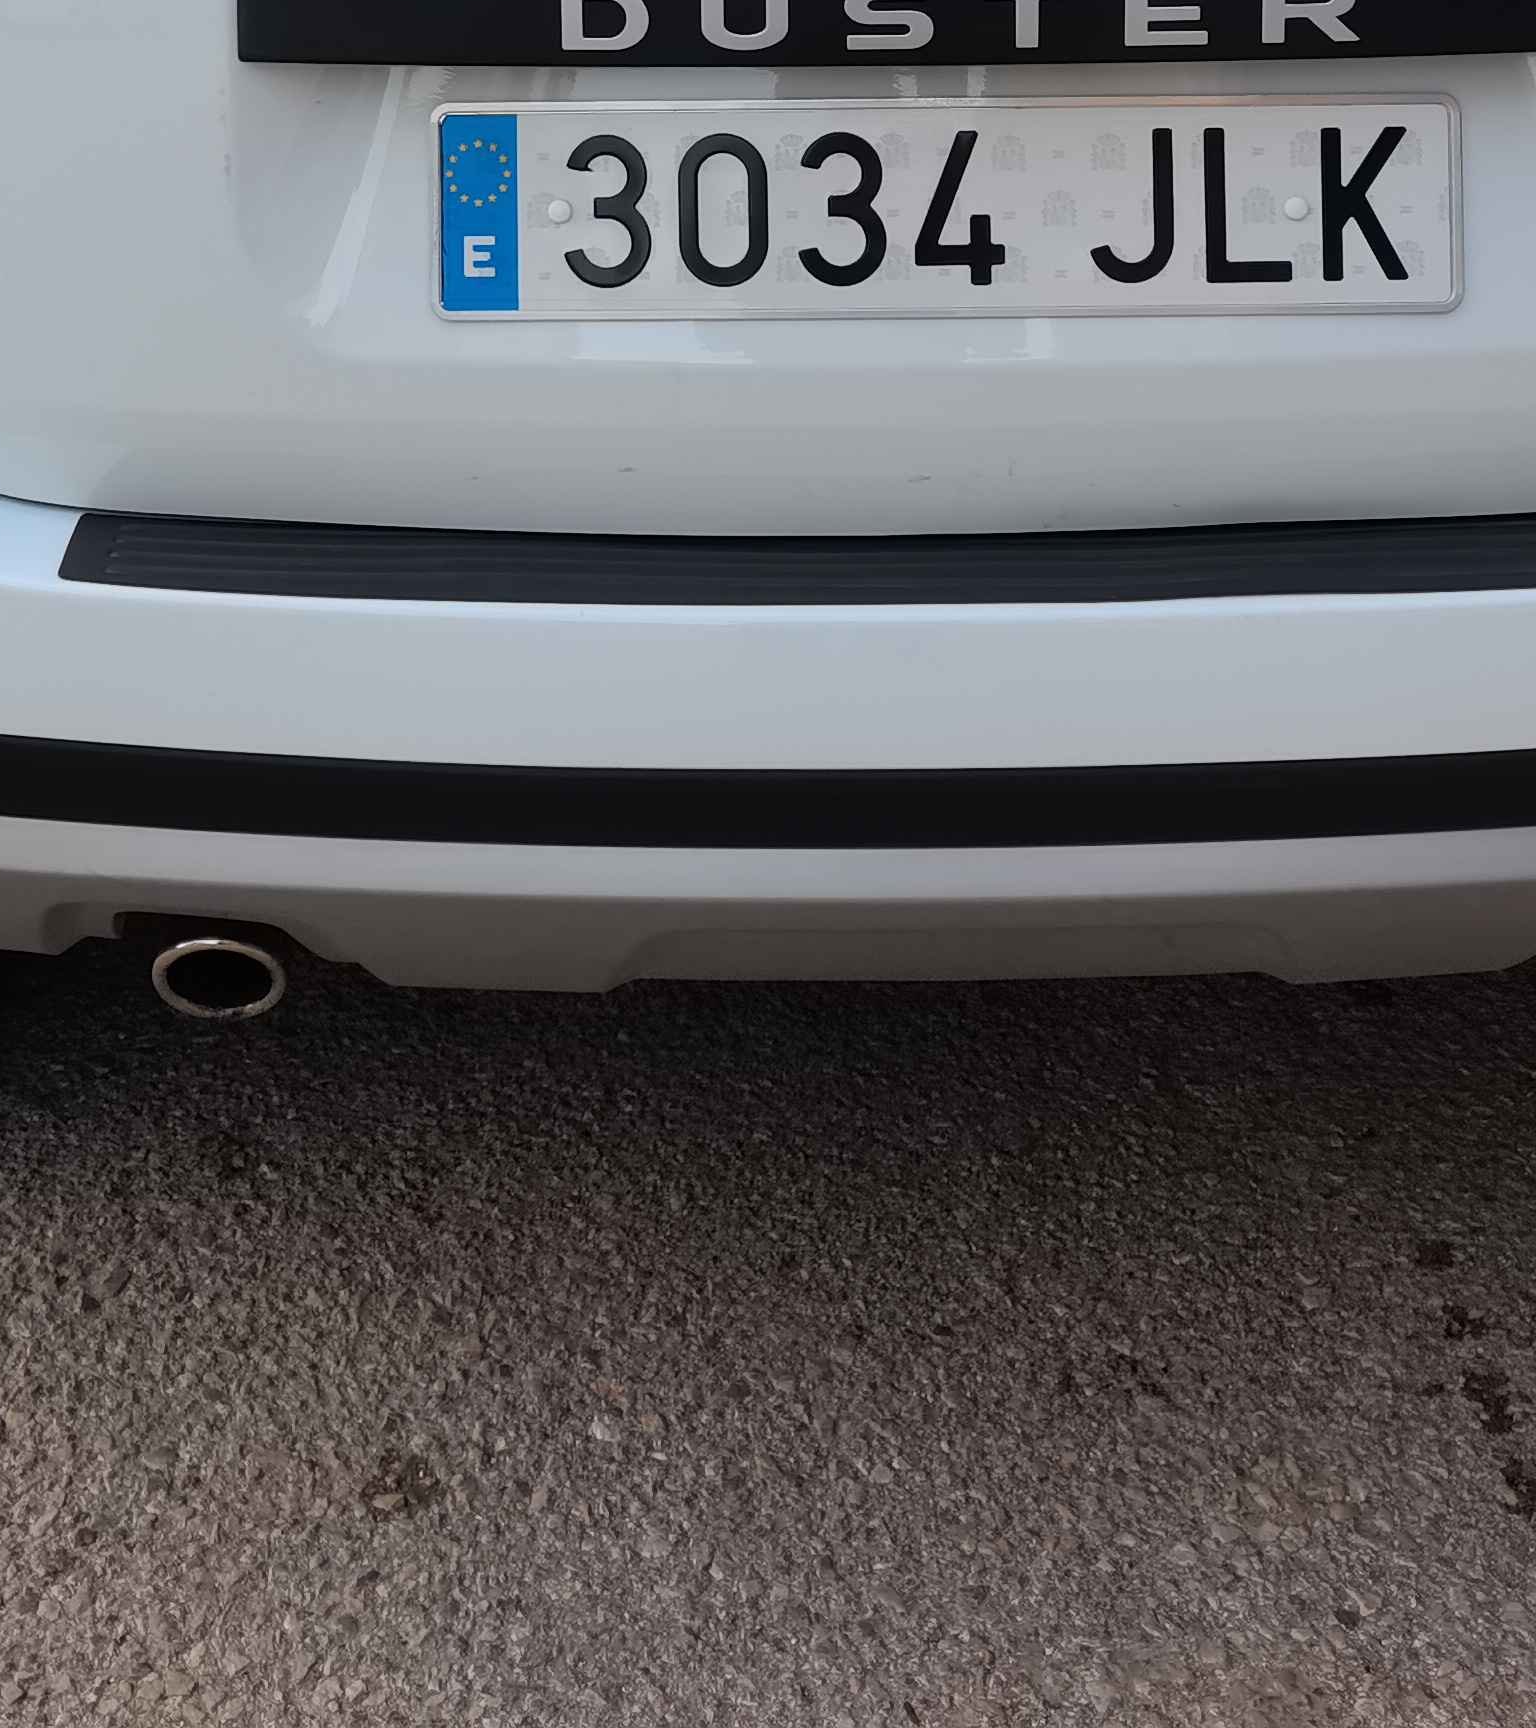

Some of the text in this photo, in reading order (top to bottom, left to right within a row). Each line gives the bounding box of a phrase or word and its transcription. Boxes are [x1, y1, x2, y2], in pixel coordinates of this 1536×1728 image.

[463, 235, 496, 278] E
[564, 125, 1410, 289] 3034 JLK
